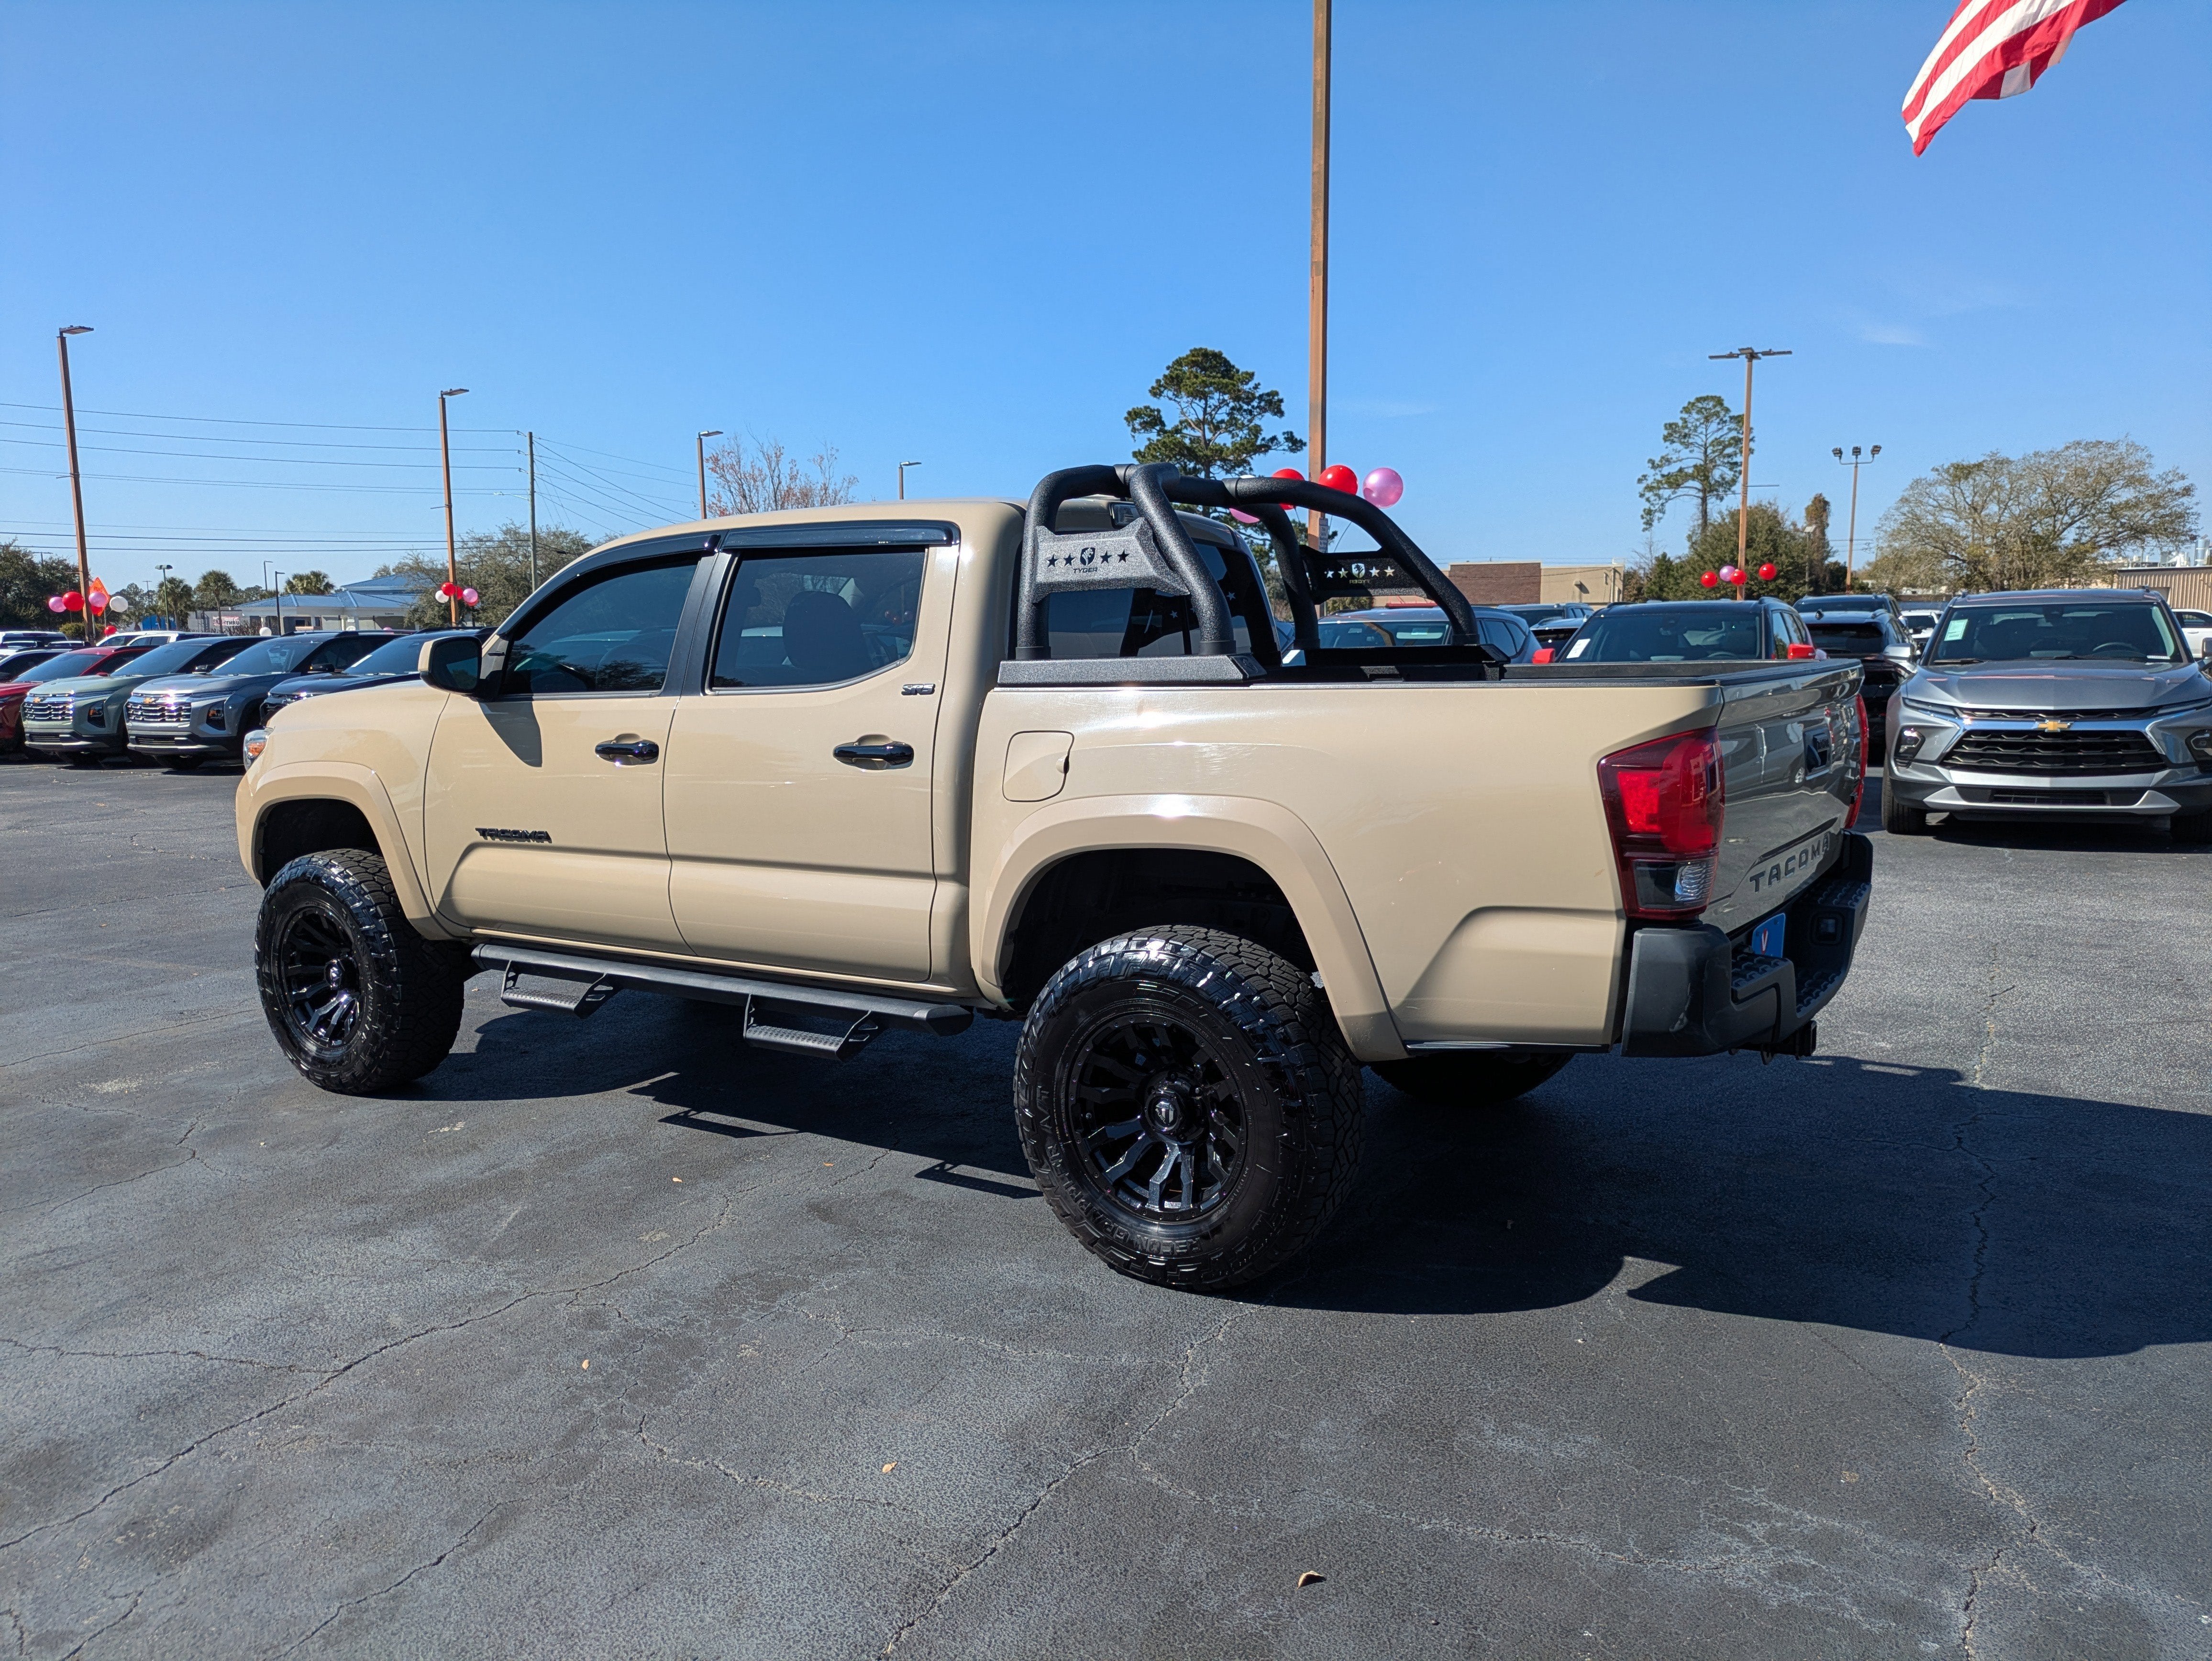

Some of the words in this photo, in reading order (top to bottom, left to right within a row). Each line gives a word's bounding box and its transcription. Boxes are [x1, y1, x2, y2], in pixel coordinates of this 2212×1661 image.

[901, 683, 936, 696] SR5
[475, 827, 553, 844] TACOMA
[1749, 830, 1831, 893] TACOMA
[1047, 1145, 1131, 1245] GRAPPLER
[1133, 1234, 1203, 1255] RECON
